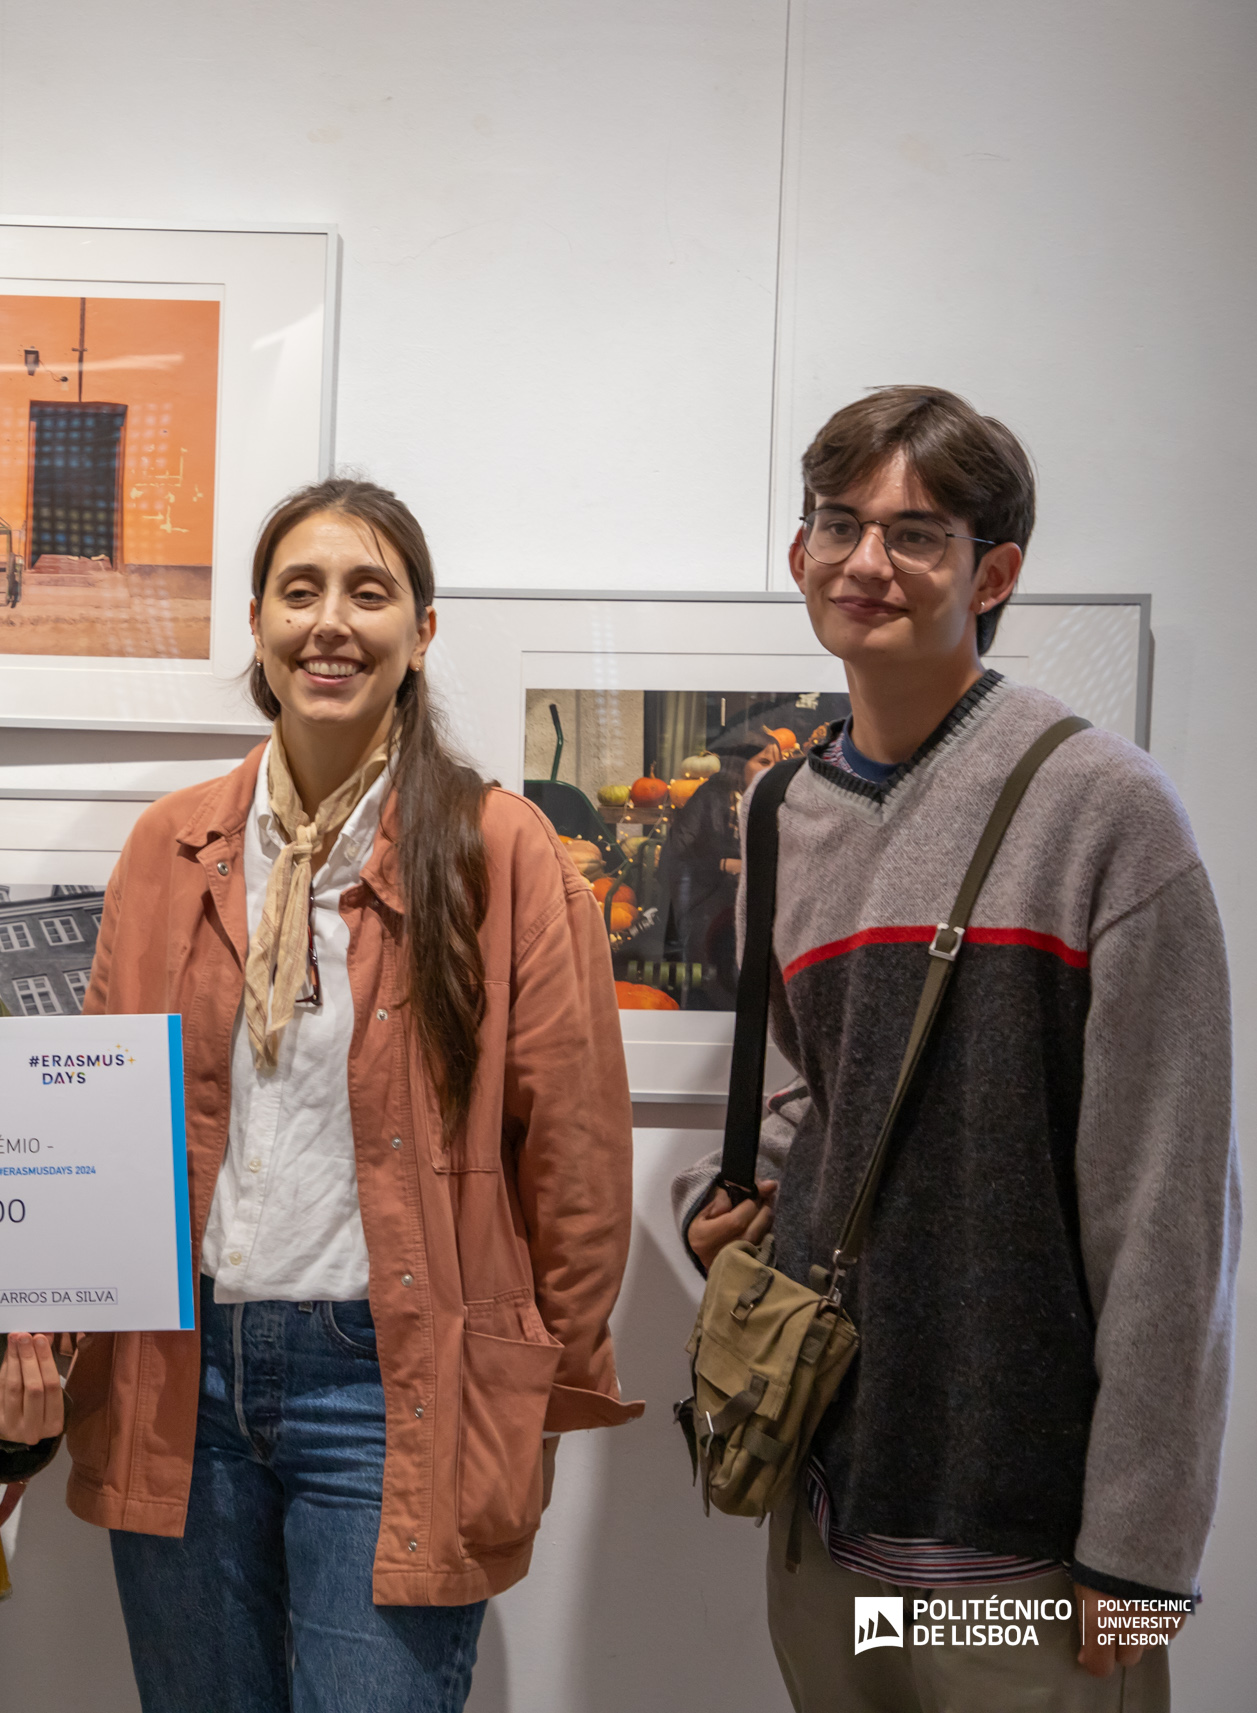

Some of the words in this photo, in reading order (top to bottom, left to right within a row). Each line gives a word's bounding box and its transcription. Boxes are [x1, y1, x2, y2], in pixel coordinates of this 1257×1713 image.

[29, 1054, 125, 1067] #ERASMUS
[42, 1071, 86, 1085] DAYS
[75, 1166, 96, 1175] 2024
[51, 1291, 71, 1303] DA
[75, 1290, 115, 1303] SILVA
